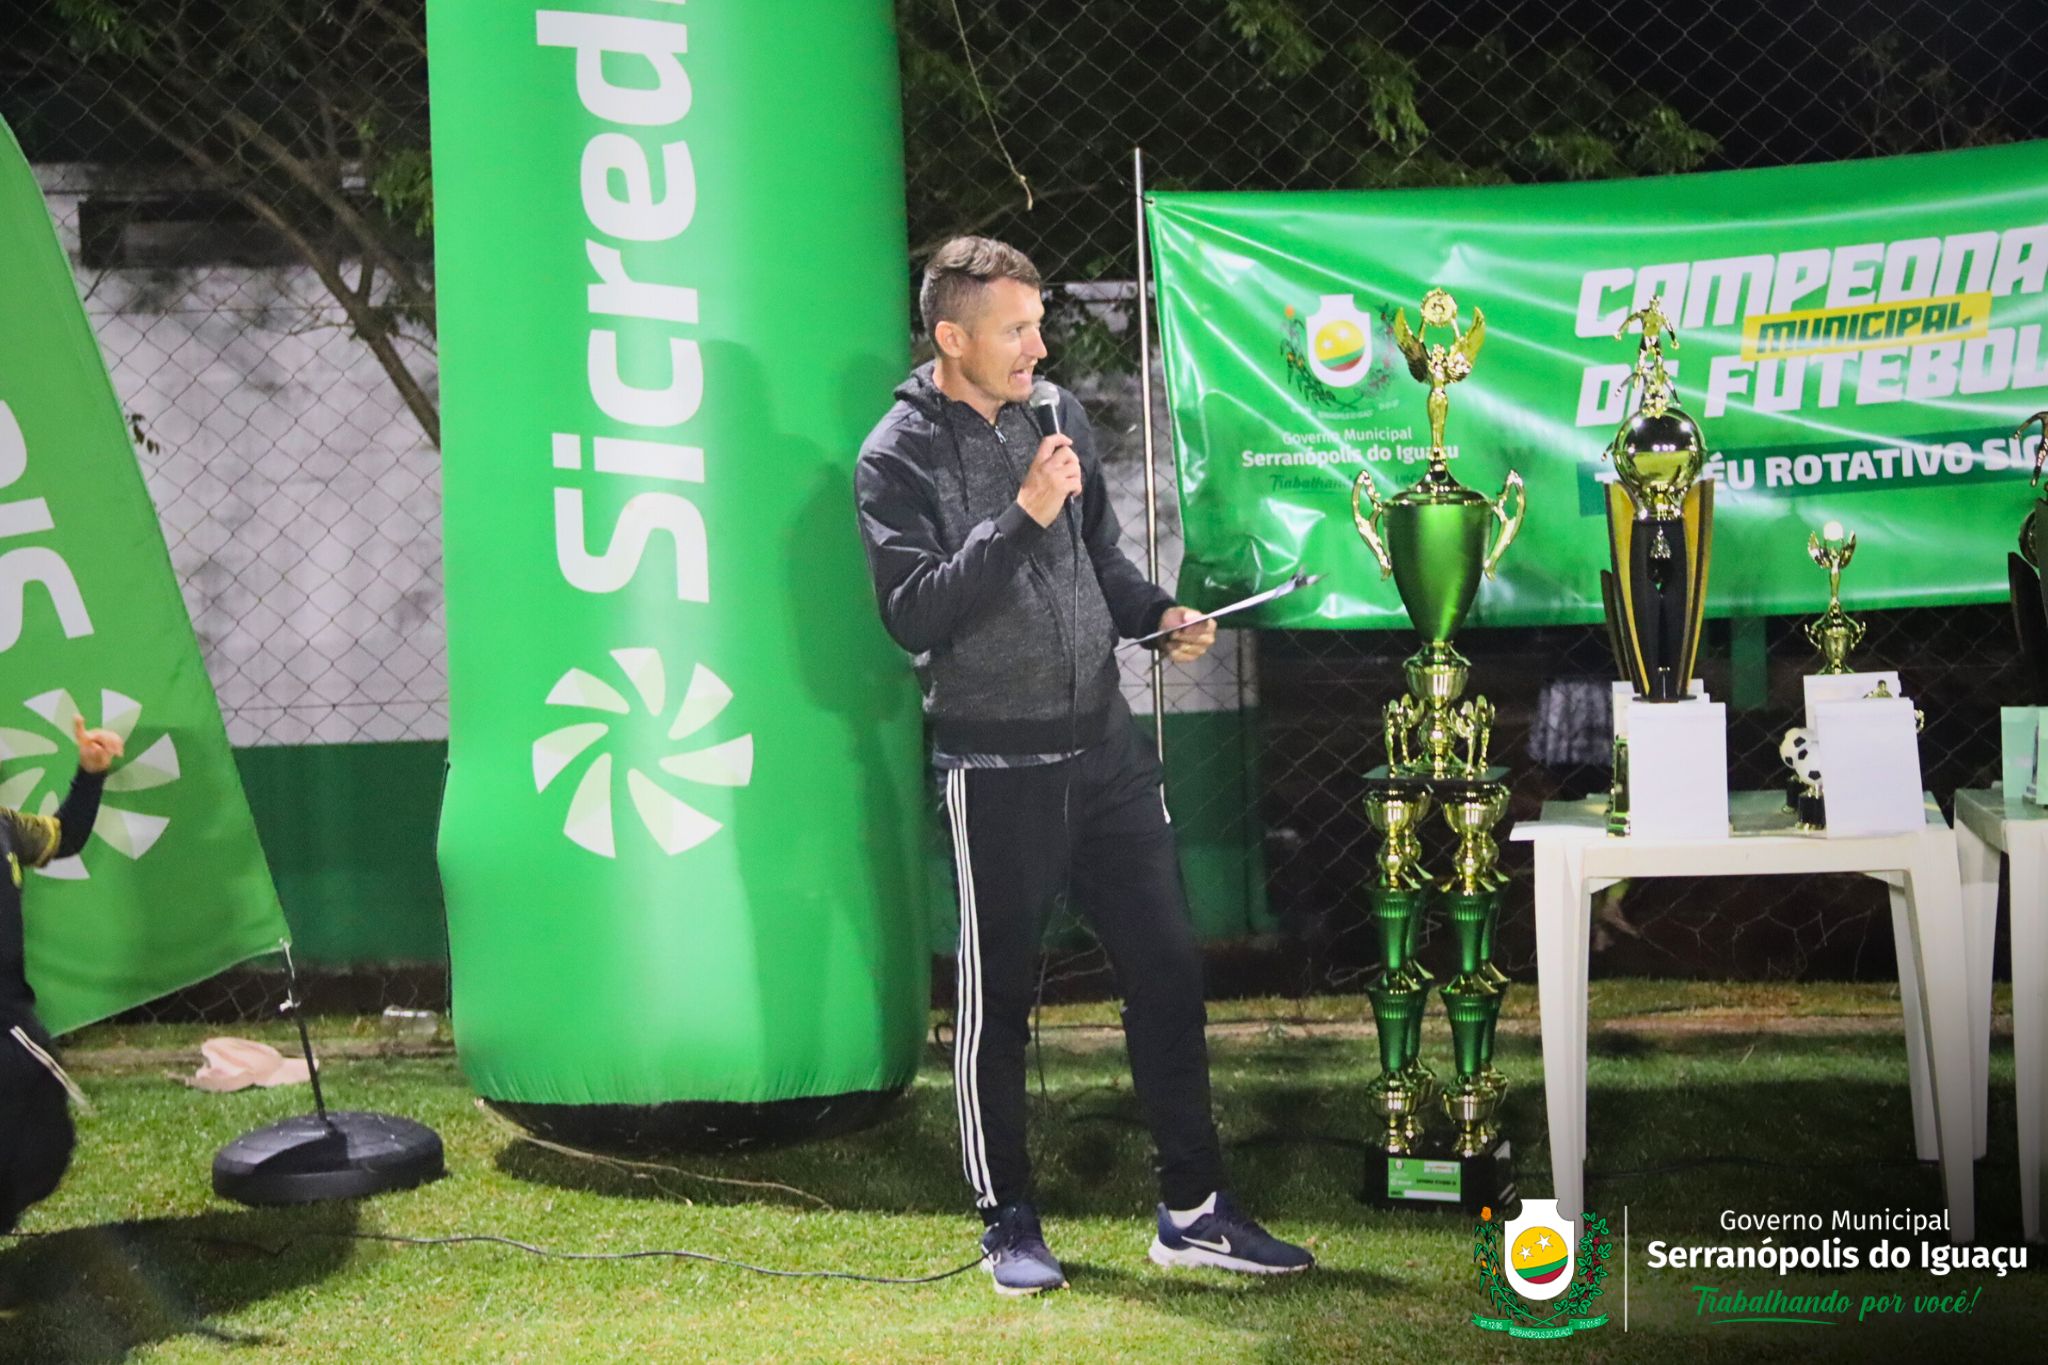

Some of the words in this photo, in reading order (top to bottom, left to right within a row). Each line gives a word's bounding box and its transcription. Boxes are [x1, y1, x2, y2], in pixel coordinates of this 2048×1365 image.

[536, 0, 709, 604] Sicred
[1756, 301, 1972, 354] MUNICIPAL
[1704, 324, 2048, 418] FUTEBOL
[1344, 426, 1413, 444] Municipal
[1367, 445, 1392, 464] do
[1396, 444, 1459, 465] Iguu
[1765, 441, 1974, 488] ROTATIVO
